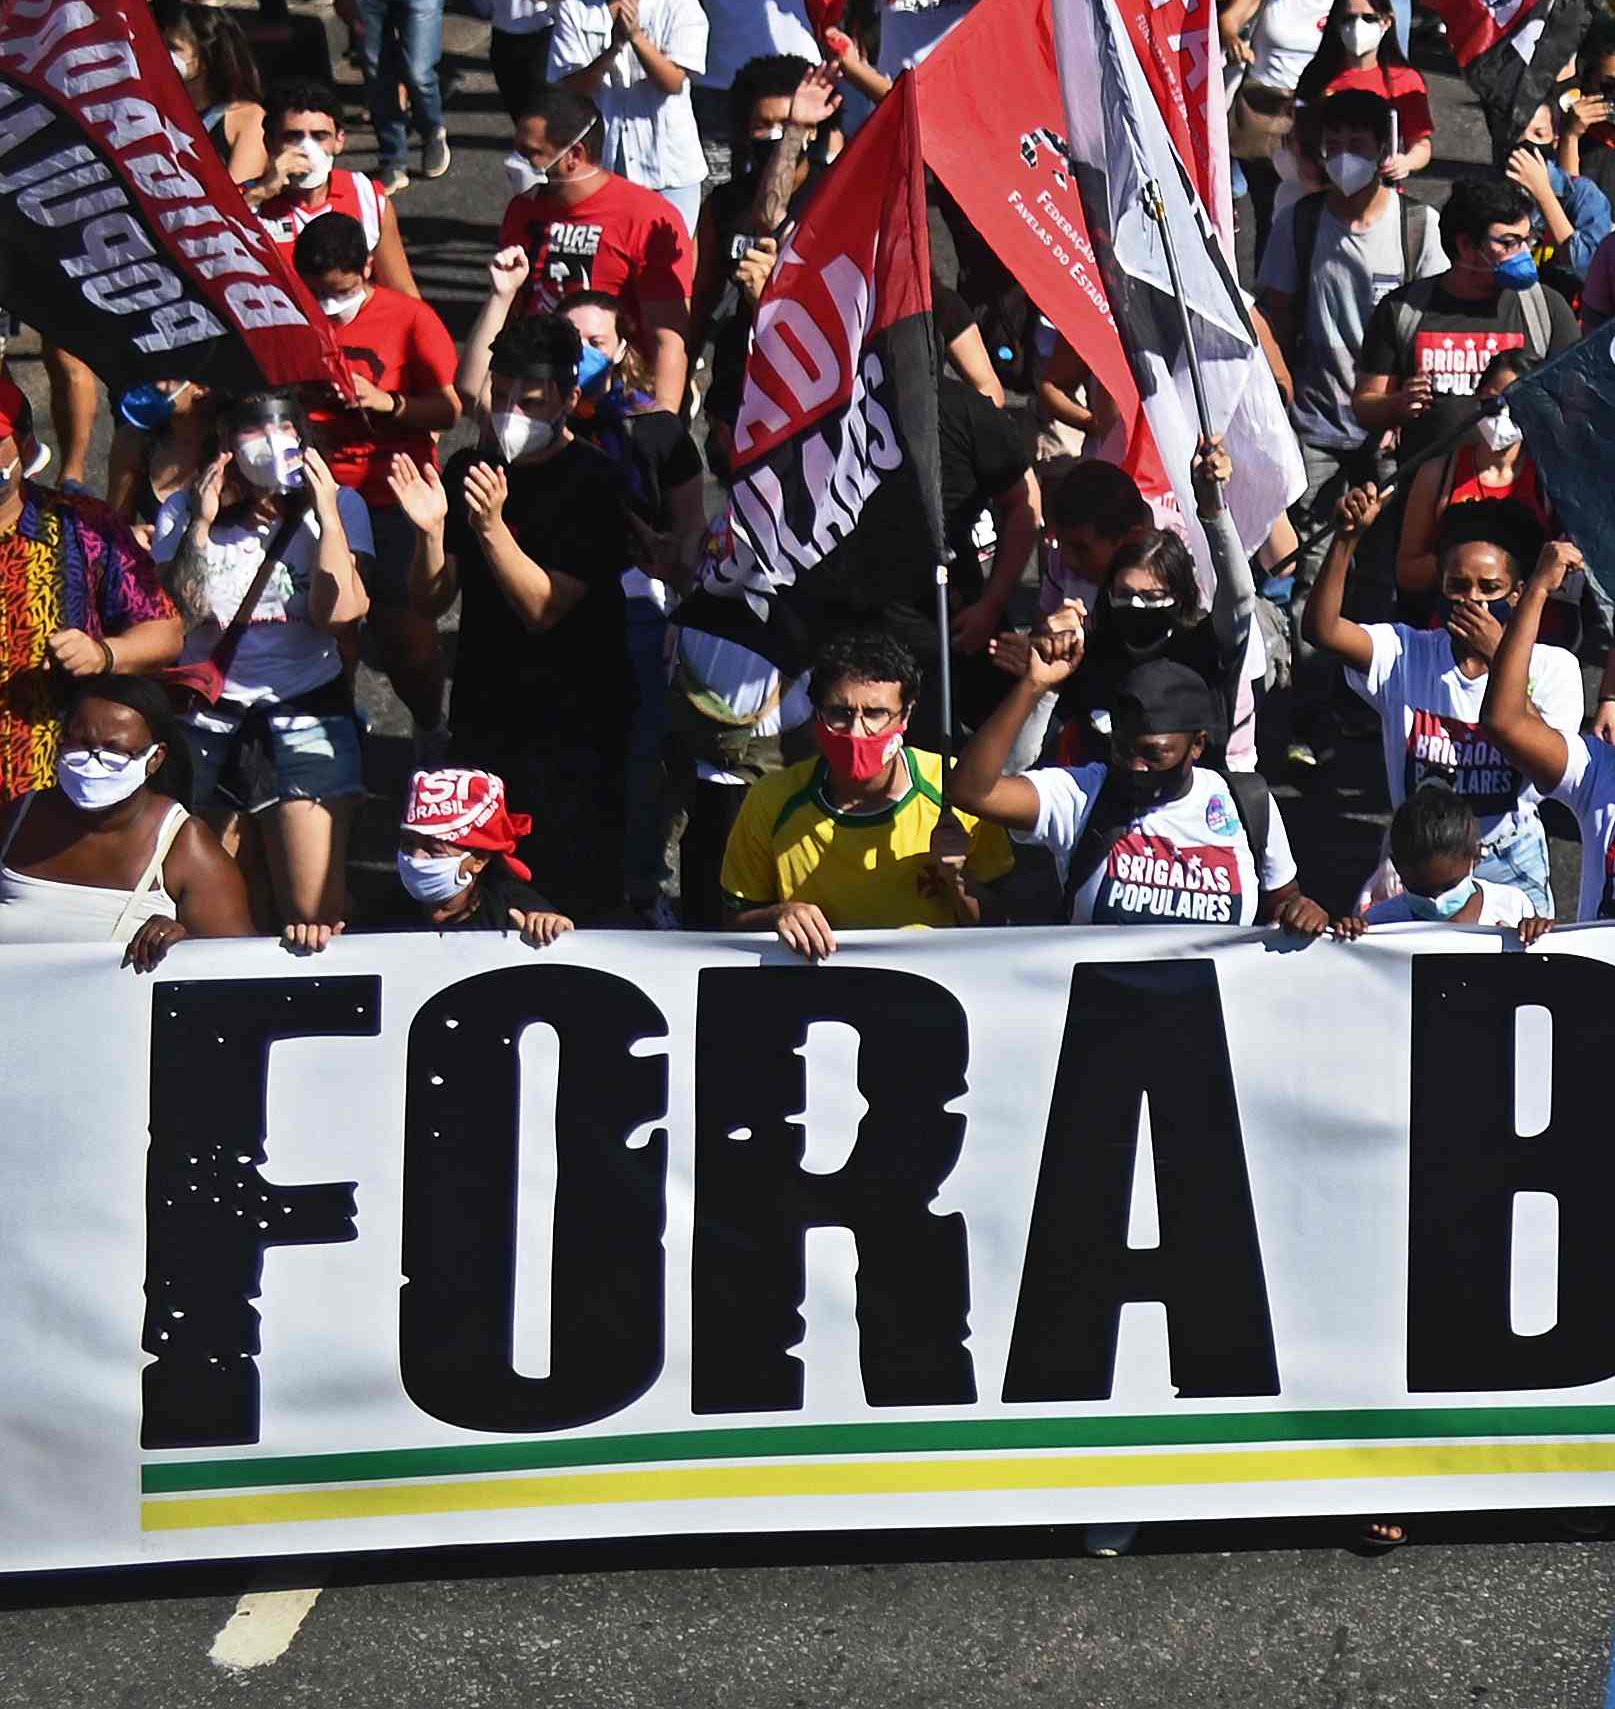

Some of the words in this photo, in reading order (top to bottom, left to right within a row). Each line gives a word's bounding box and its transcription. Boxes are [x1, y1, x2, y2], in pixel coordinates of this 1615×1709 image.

[1006, 189, 1054, 247] FAVELAS
[1051, 243, 1071, 267] DO
[1068, 261, 1111, 315] ESTADO
[1107, 881, 1233, 924] POPULARES
[1114, 851, 1233, 892] BRIGADAS
[140, 959, 1284, 1451] FORA
